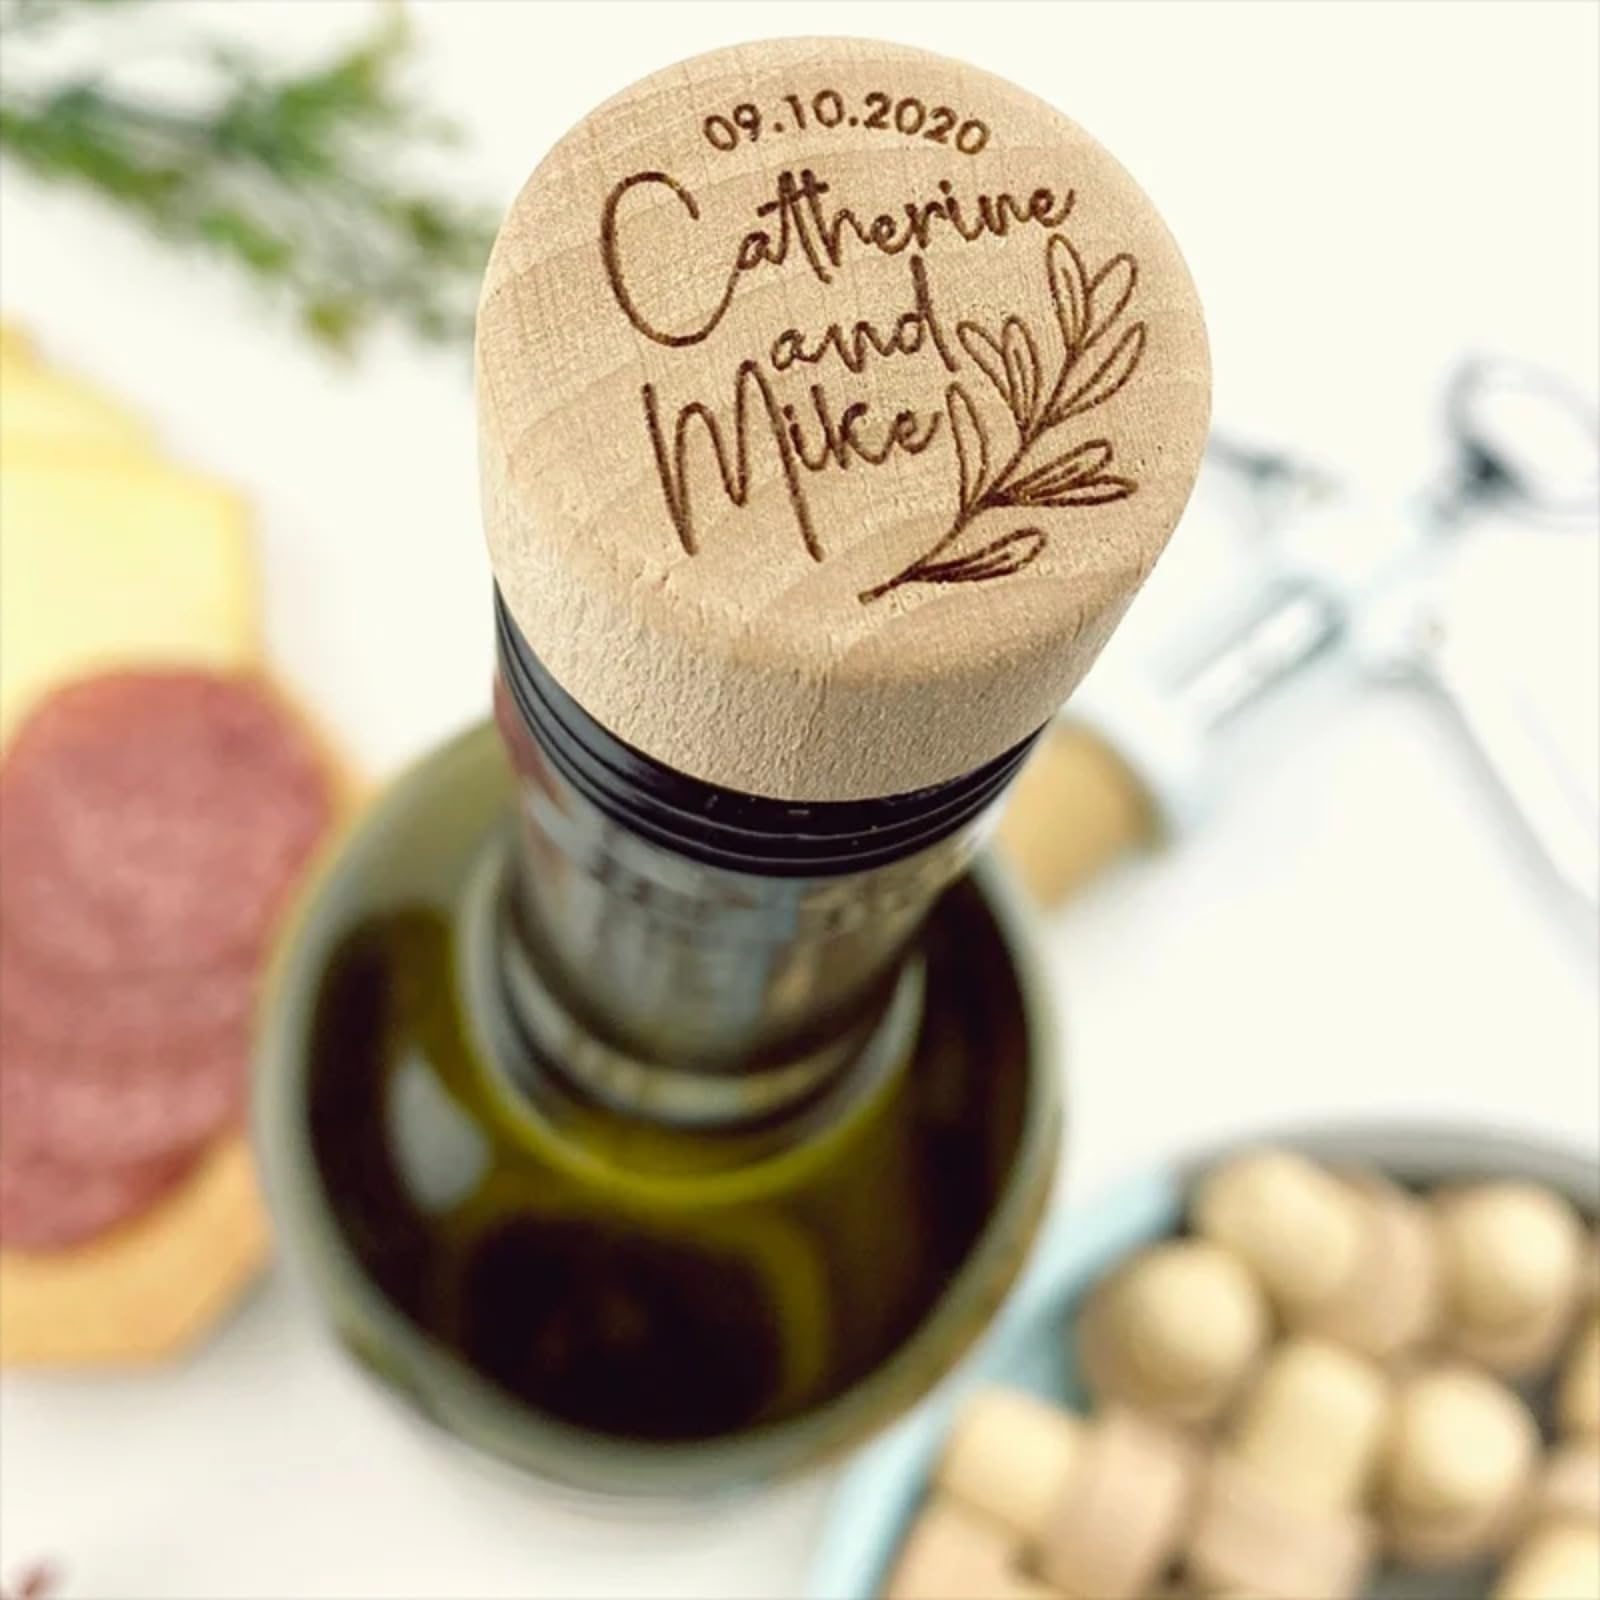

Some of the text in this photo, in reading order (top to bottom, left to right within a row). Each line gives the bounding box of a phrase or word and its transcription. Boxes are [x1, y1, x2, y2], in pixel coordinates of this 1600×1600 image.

[703, 90, 991, 156] 09.10.2020
[600, 168, 1077, 347] Catherine
[771, 256, 962, 373] and
[641, 359, 942, 563] Mike
